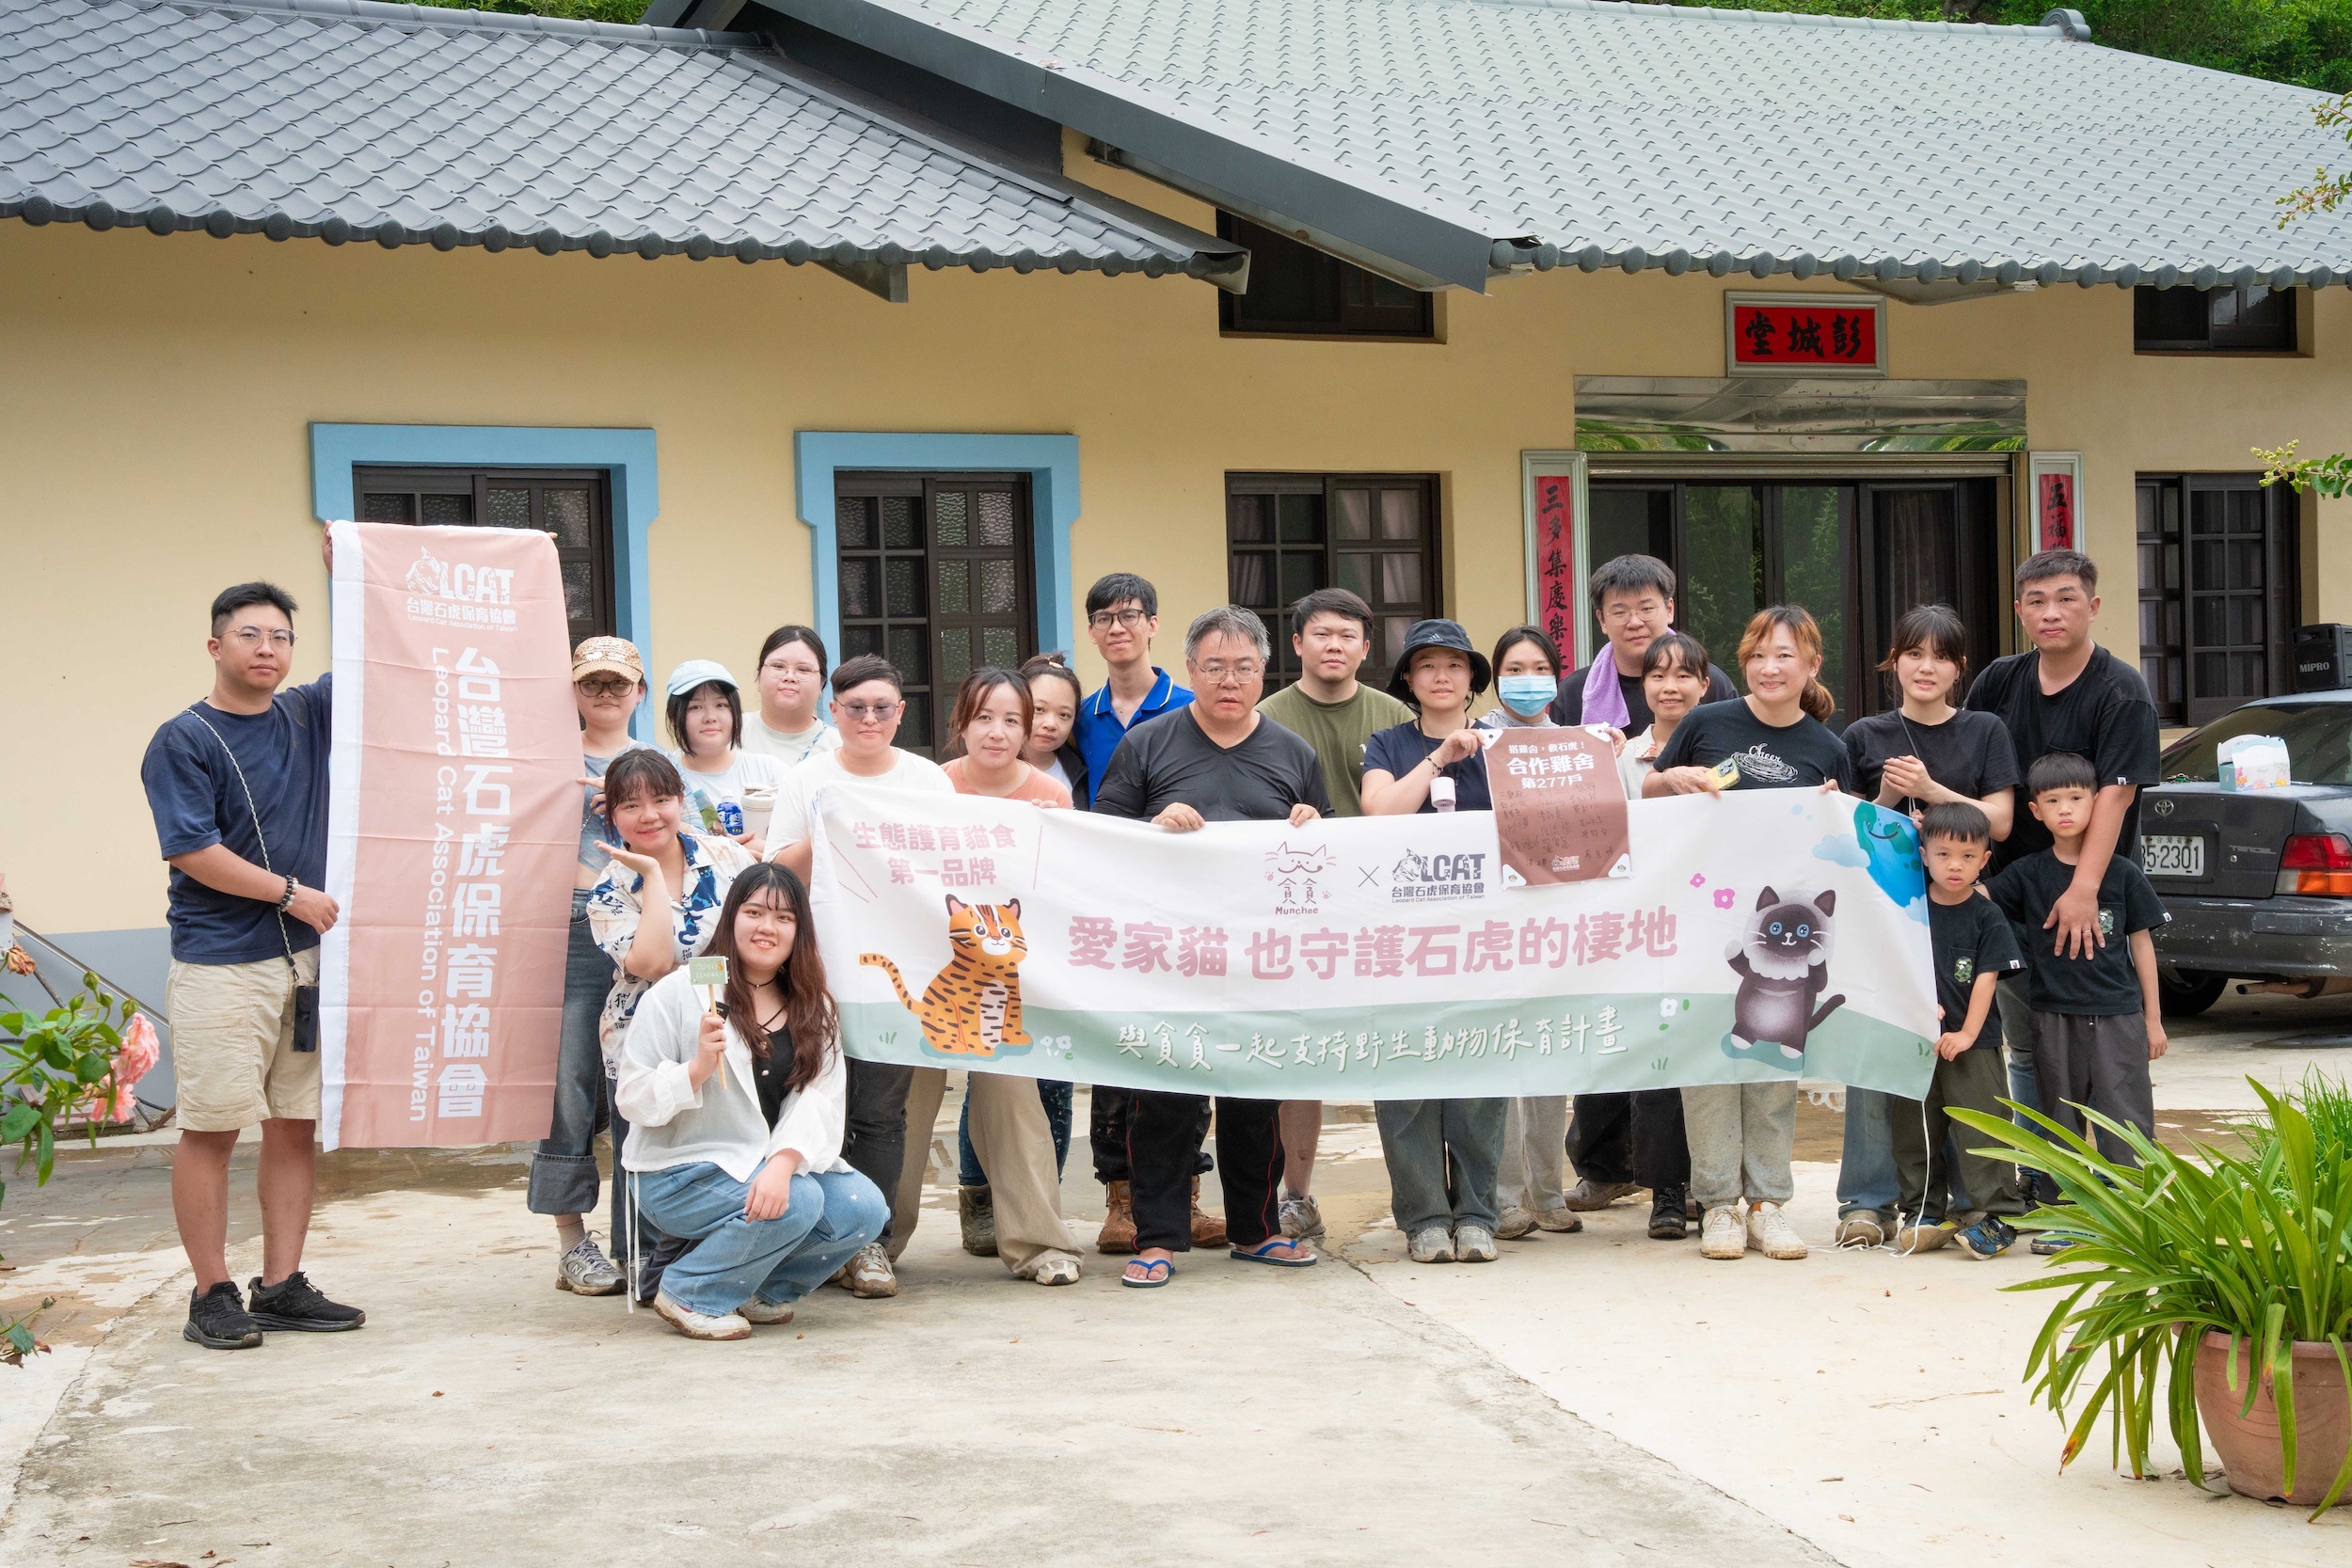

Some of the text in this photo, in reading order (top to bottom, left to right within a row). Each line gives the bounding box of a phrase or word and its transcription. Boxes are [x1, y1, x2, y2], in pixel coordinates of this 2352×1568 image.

[2047, 483, 2067, 549] 五福
[406, 596, 516, 625] 台灣石虎保育協會
[408, 613, 435, 624] Leopard
[436, 617, 447, 626] Cat
[449, 620, 486, 631] Association
[2299, 661, 2330, 673] MIPRO
[1506, 752, 1595, 776] 合作雞舍
[852, 821, 1017, 852] 生態護育貓食
[409, 647, 458, 1122] Leopard Cat Association of Taiwan
[437, 646, 514, 1118] 台灣石虎保育協會
[887, 857, 997, 887] 第一品牌
[1391, 882, 1485, 898] 台灣石虎保育協會
[1275, 906, 1319, 915] Munchee
[1068, 905, 1678, 980] 愛家貓 也守護石虎的棲地
